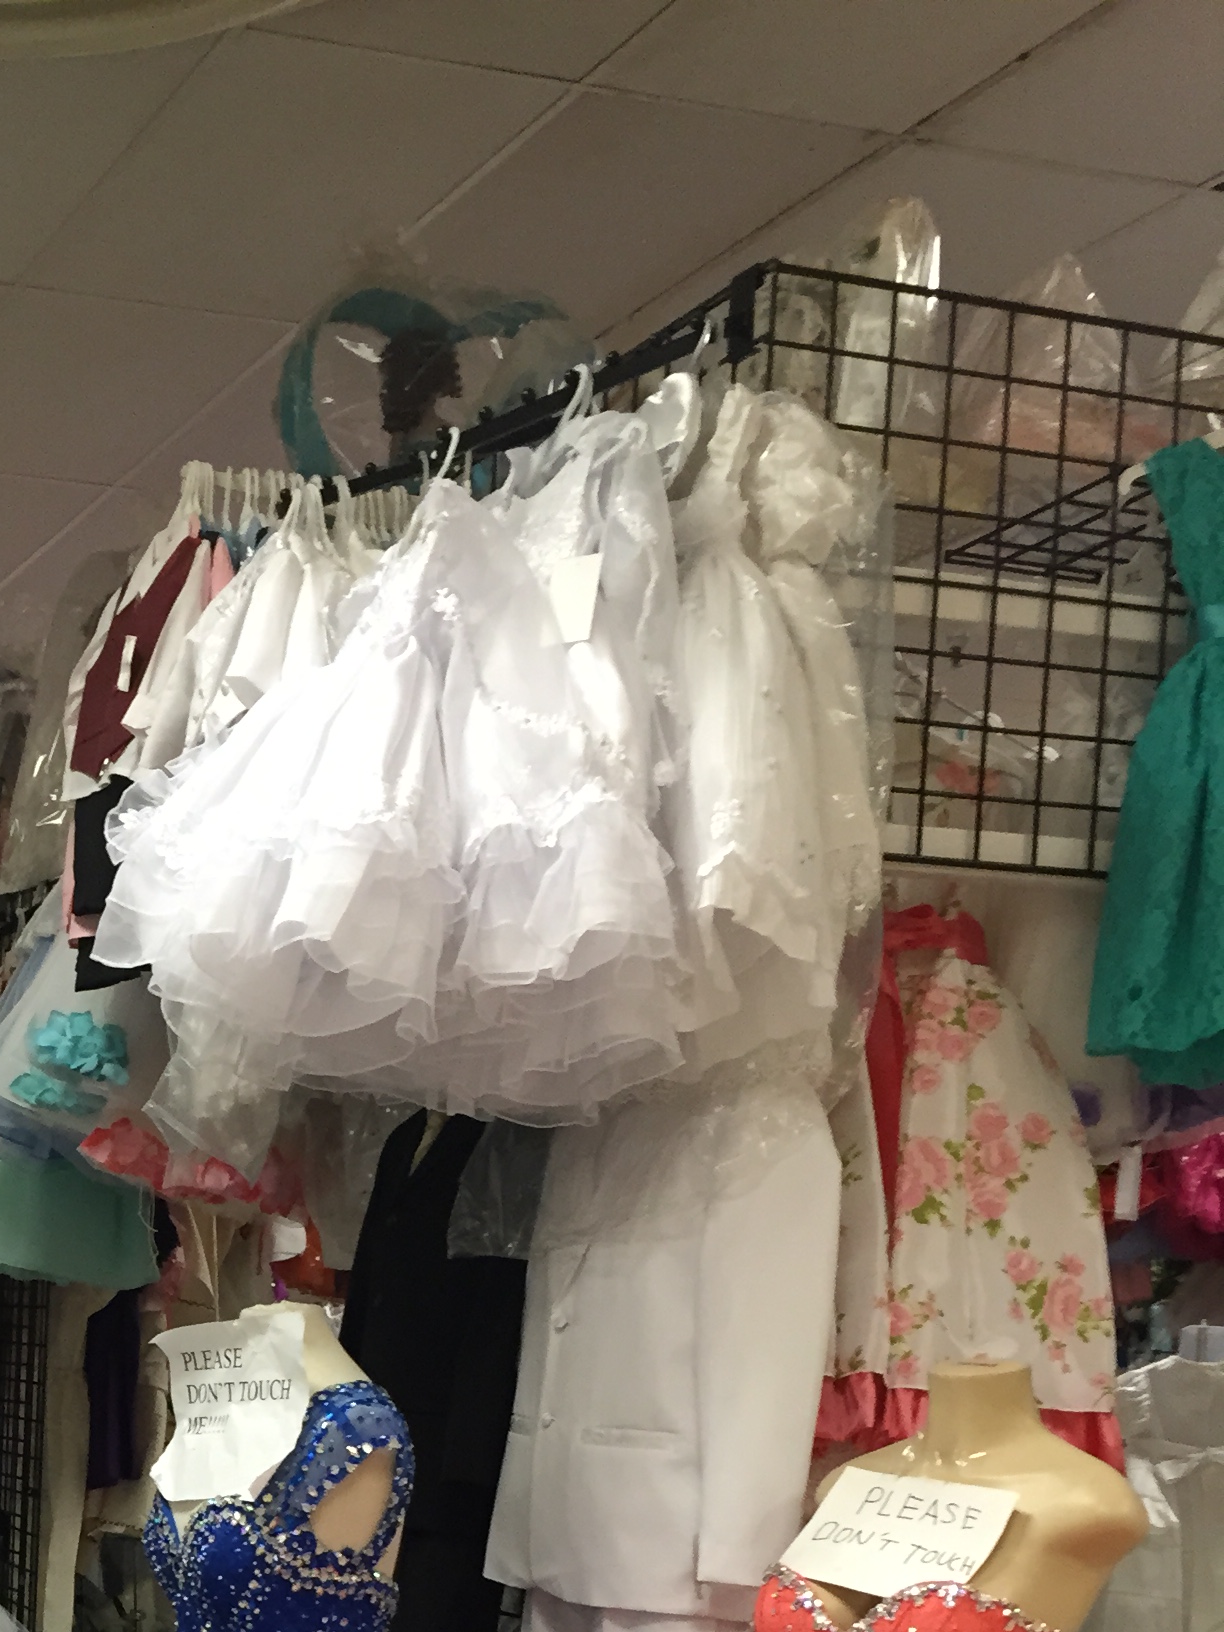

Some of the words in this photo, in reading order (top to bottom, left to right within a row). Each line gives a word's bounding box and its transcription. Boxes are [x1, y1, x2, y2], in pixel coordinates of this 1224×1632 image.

[181, 1347, 243, 1372] PLEASE
[187, 1382, 235, 1404] DON'T
[239, 1378, 292, 1402] TOUCH
[855, 1485, 983, 1530] PLEASE
[811, 1520, 900, 1551] DON'T
[902, 1542, 978, 1577] TOUCH
